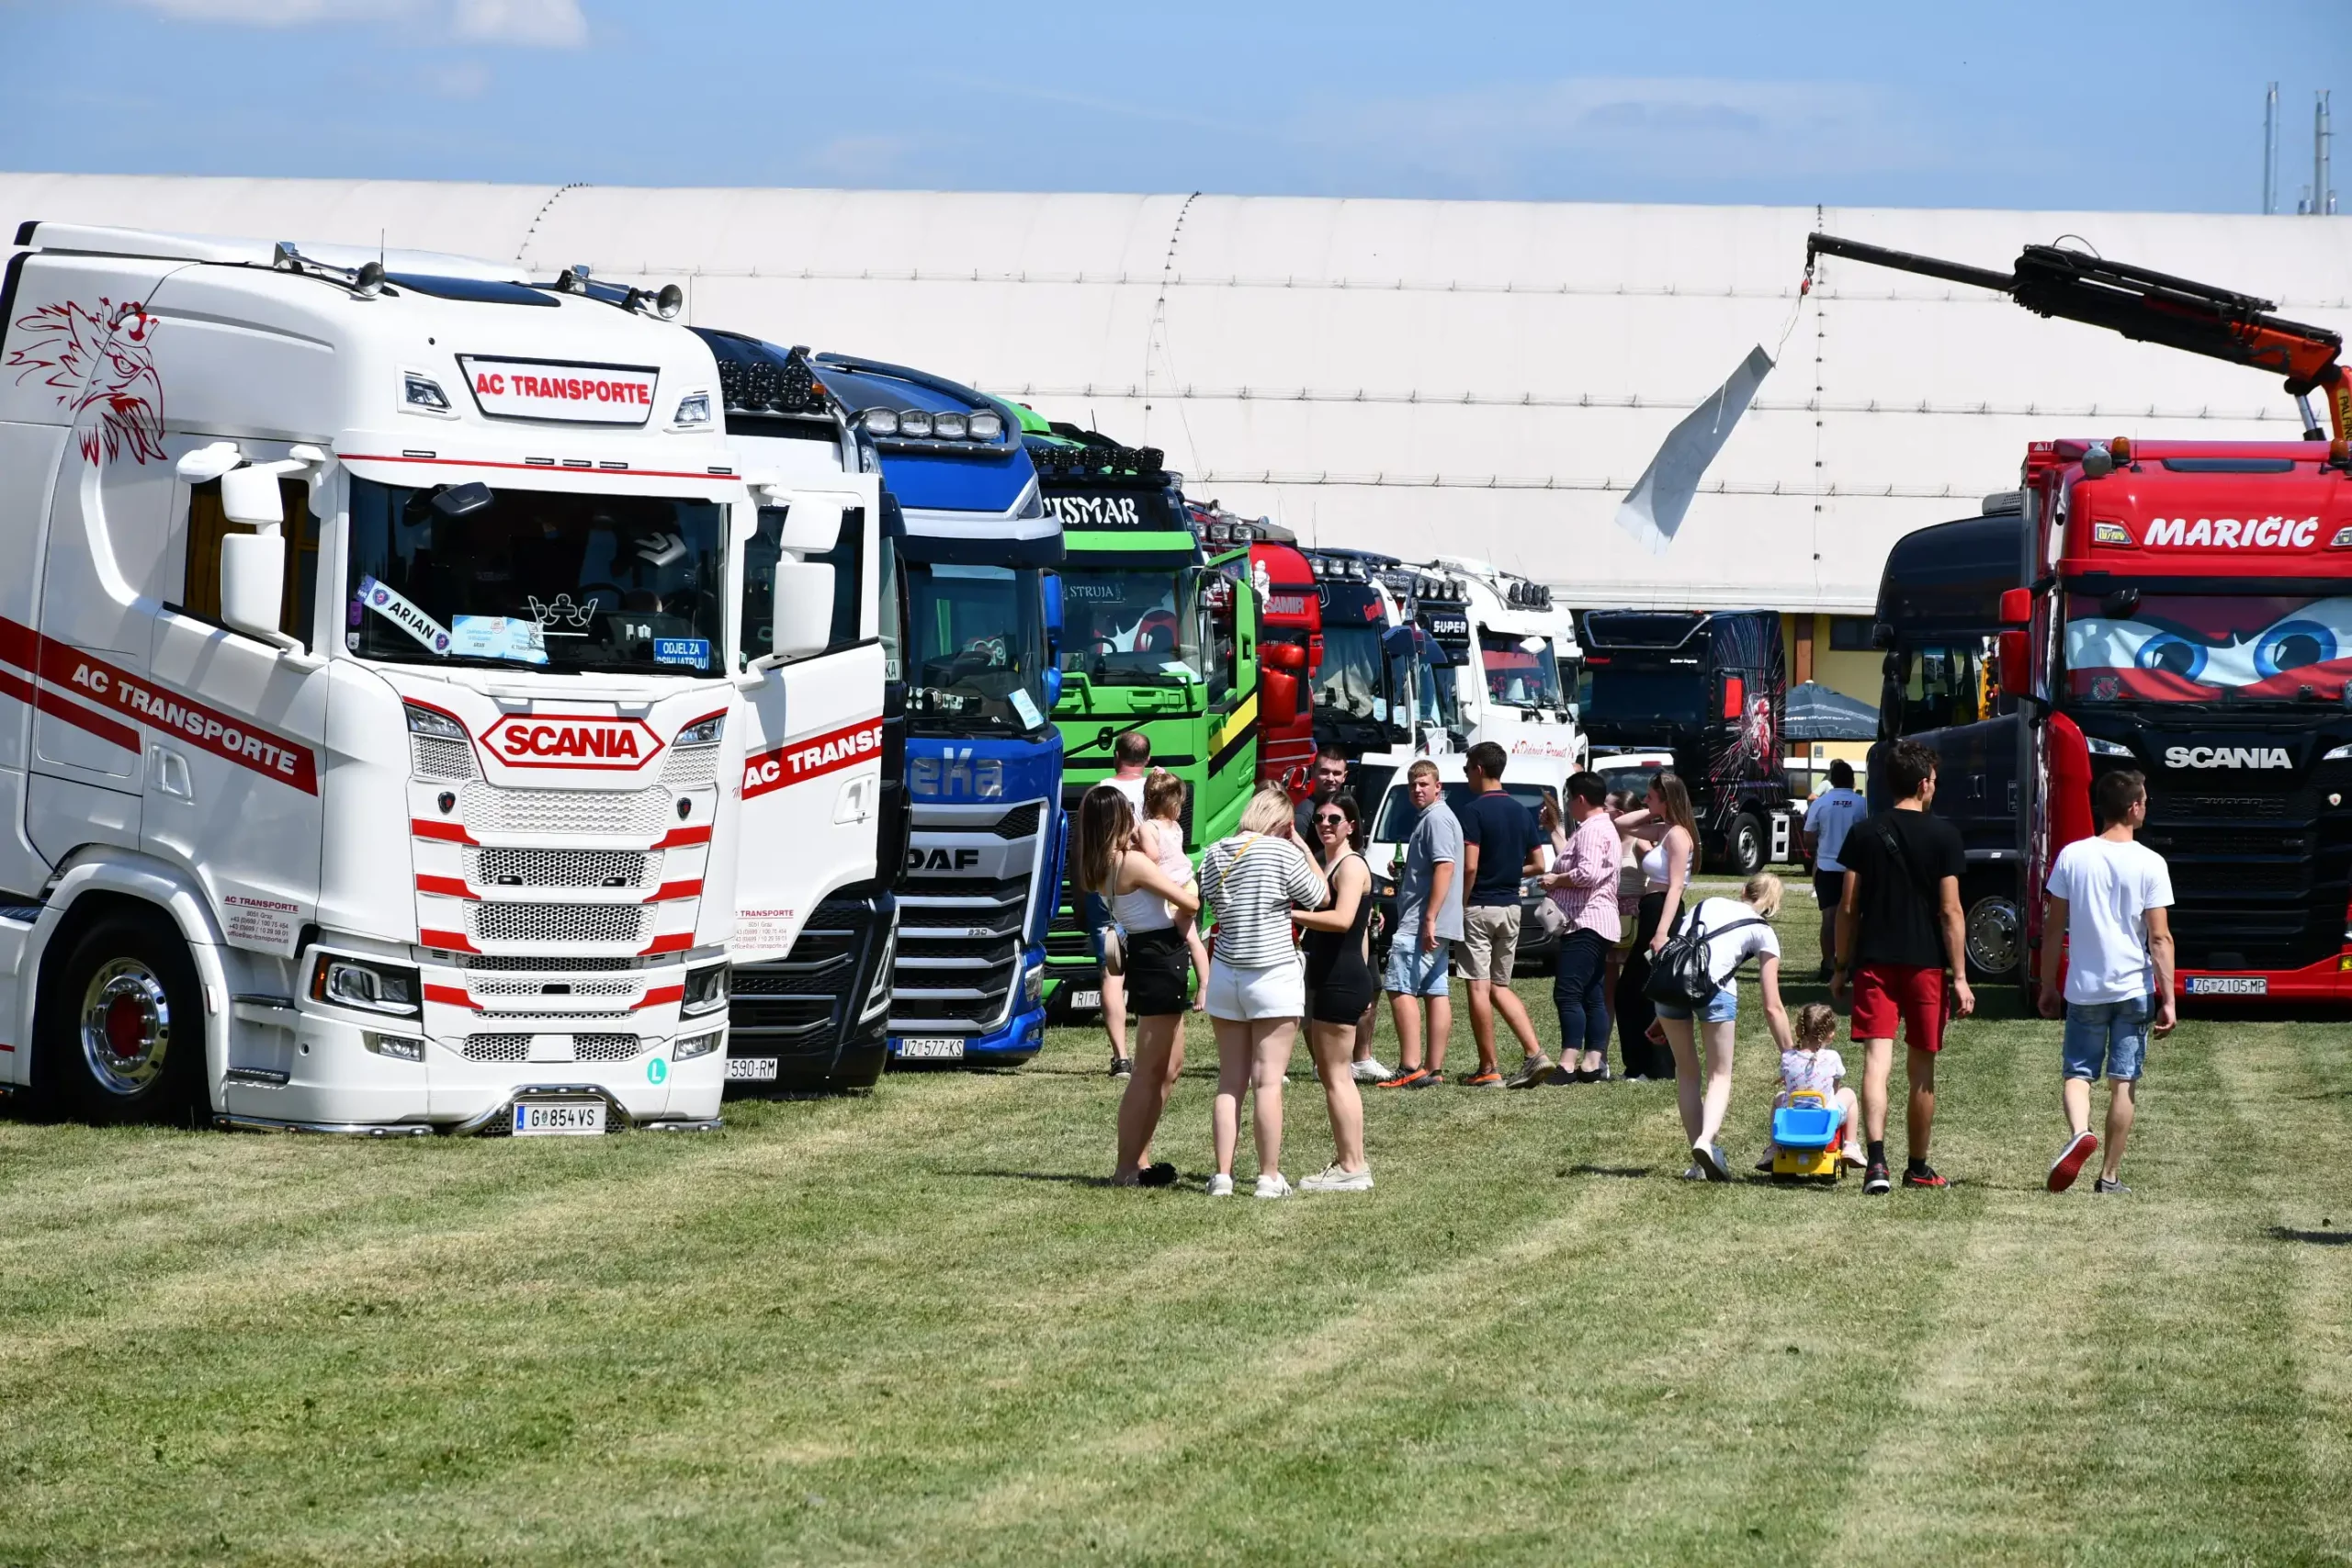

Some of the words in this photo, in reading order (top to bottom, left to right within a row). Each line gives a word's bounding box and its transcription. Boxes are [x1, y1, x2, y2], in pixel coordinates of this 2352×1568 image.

[476, 374, 504, 396] AC
[511, 375, 650, 405] TRANSPORTE
[2143, 516, 2319, 548] MARIČIĆ
[1069, 586, 1114, 598] STRUJA
[1264, 596, 1305, 614] SAMIR
[388, 602, 436, 639] ARIAN
[1433, 620, 1466, 633] SUPER
[662, 642, 687, 655] ODJEL
[689, 642, 700, 655] ZA
[72, 663, 108, 694] AC
[118, 681, 297, 775] TRANSPORTE
[504, 725, 639, 758] SCANIA
[2165, 747, 2293, 769] SCANIA
[743, 761, 780, 790] AC
[904, 747, 1002, 796] eKa
[908, 848, 979, 871] DAF
[224, 896, 237, 904] AC
[239, 897, 299, 912] TRANSPORTE
[2195, 979, 2210, 992] ZG
[2218, 979, 2266, 993] 2105-MP
[923, 1040, 963, 1056] 577-KS
[652, 1062, 662, 1081] L
[731, 1060, 775, 1077] 590-RM
[531, 1109, 540, 1126] G
[549, 1109, 575, 1126] 854
[578, 1109, 594, 1126] VS
